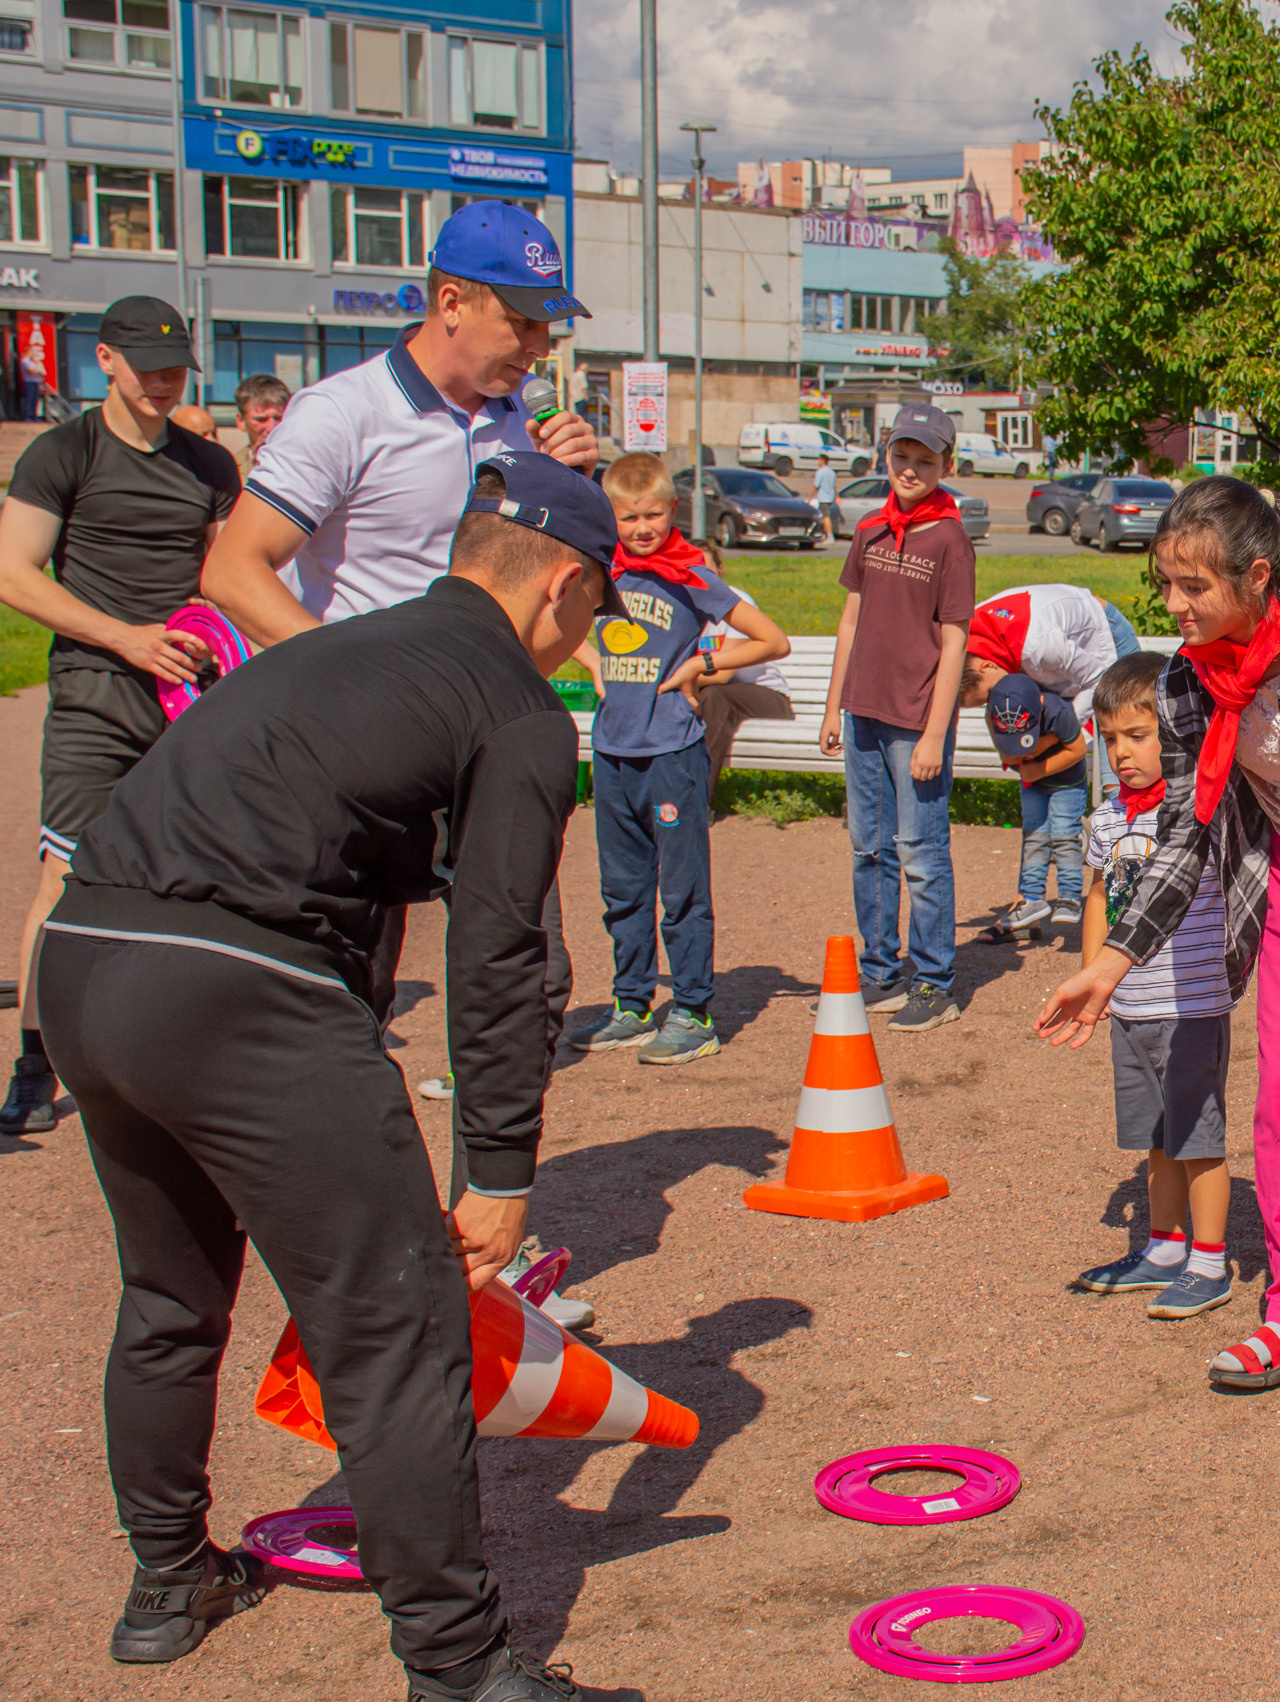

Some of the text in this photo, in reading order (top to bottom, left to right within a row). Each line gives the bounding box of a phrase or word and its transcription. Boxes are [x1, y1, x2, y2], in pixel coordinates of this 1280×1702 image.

[803, 215, 898, 249] ВЫЙ ГОРО
[0, 267, 40, 288] АК
[911, 555, 936, 570] BACK
[620, 591, 674, 631] NGELES
[131, 1590, 170, 1610] NIKE
[897, 1607, 932, 1625] TORNEO
